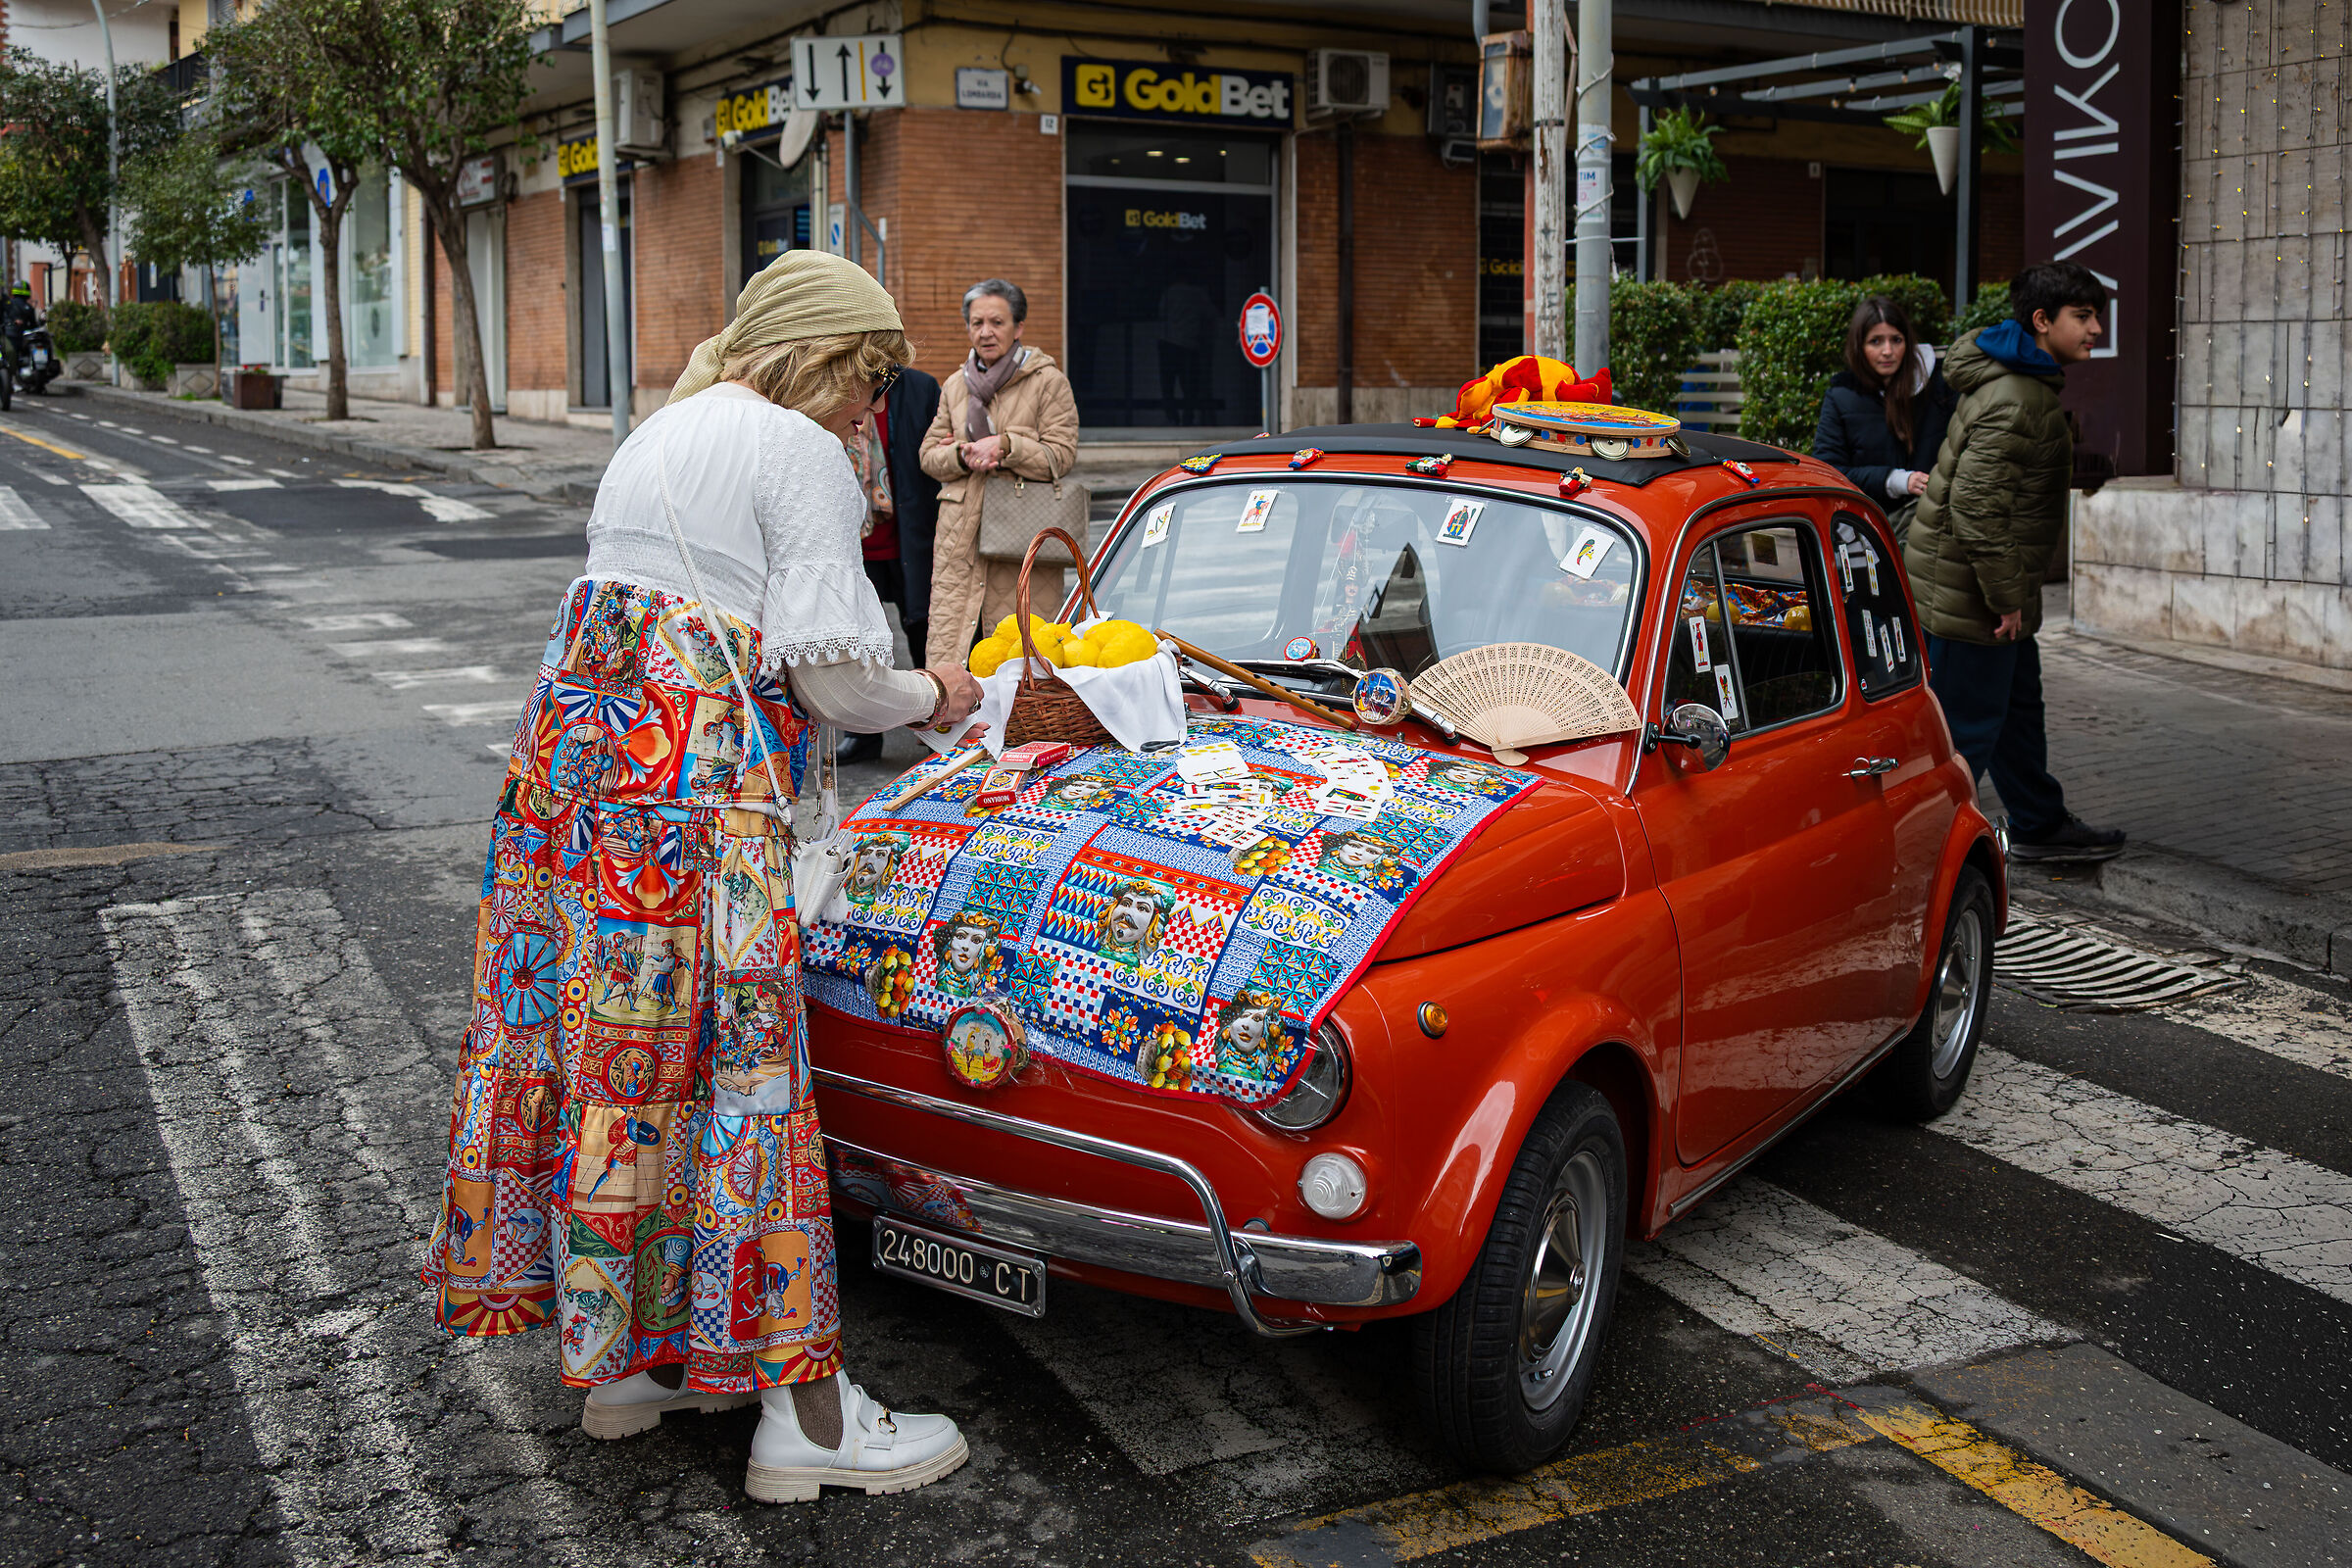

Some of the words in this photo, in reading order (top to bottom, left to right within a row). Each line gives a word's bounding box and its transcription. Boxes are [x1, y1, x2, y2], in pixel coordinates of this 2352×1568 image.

[732, 81, 793, 132] GoldBe
[1123, 68, 1289, 119] GoldBet
[570, 136, 599, 173] Gold
[1579, 172, 1595, 180] TIM
[1143, 210, 1206, 229] GoldBet
[1490, 258, 1524, 275] Gold
[983, 794, 1010, 804] MODIANO
[884, 1229, 974, 1284] 248000
[995, 1262, 1031, 1301] CT
